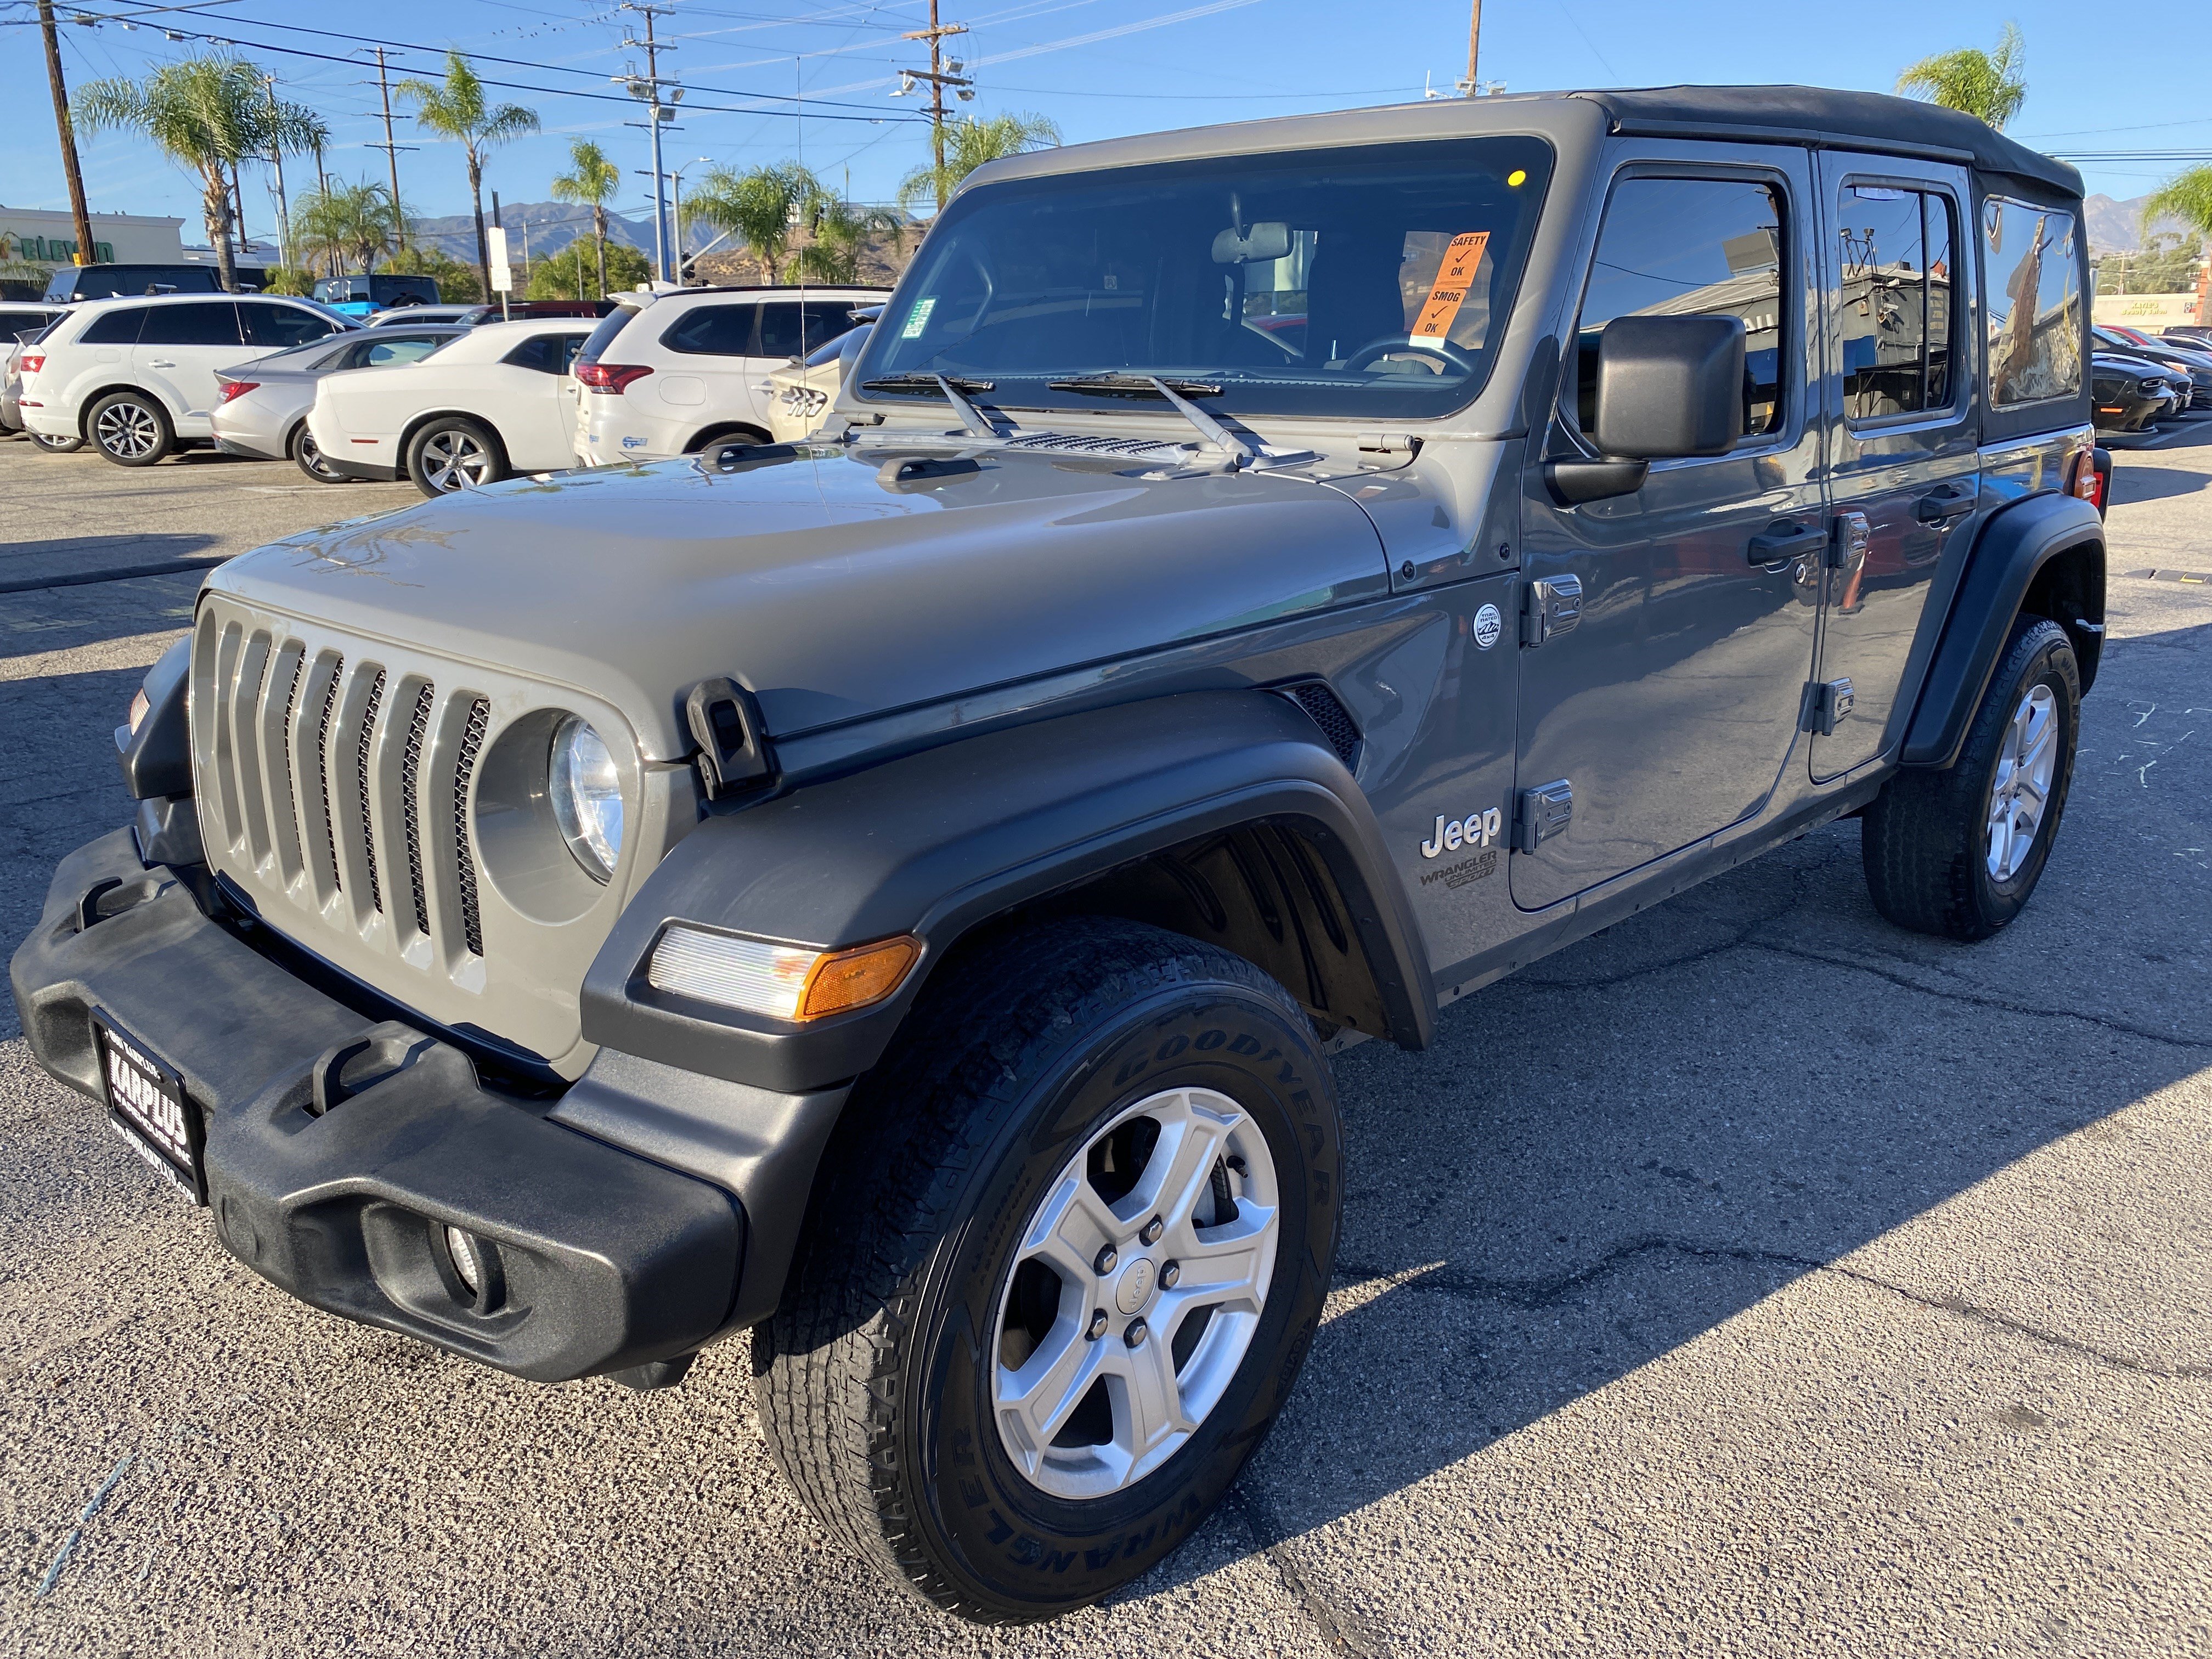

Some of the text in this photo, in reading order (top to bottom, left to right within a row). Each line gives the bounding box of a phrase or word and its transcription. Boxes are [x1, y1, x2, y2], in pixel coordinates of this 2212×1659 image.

[1451, 236, 1486, 246] SAFETY
[1451, 267, 1465, 276] OK
[1432, 291, 1460, 302] SMOG
[1425, 323, 1439, 332] OK
[1421, 807, 1501, 859] Jeep
[1420, 850, 1497, 885] WRANGLER
[1445, 859, 1497, 882] UNLIMITED
[1448, 868, 1494, 889] SPORT
[125, 1041, 159, 1079] KARPLUS
[110, 1049, 187, 1146] KARPLUS
[112, 1087, 192, 1166] WAREHOUSE INC
[1113, 1029, 1330, 1206] GOODYEAR
[1128, 1266, 1146, 1309] Jeep
[951, 1427, 1203, 1573] WRANGLER
